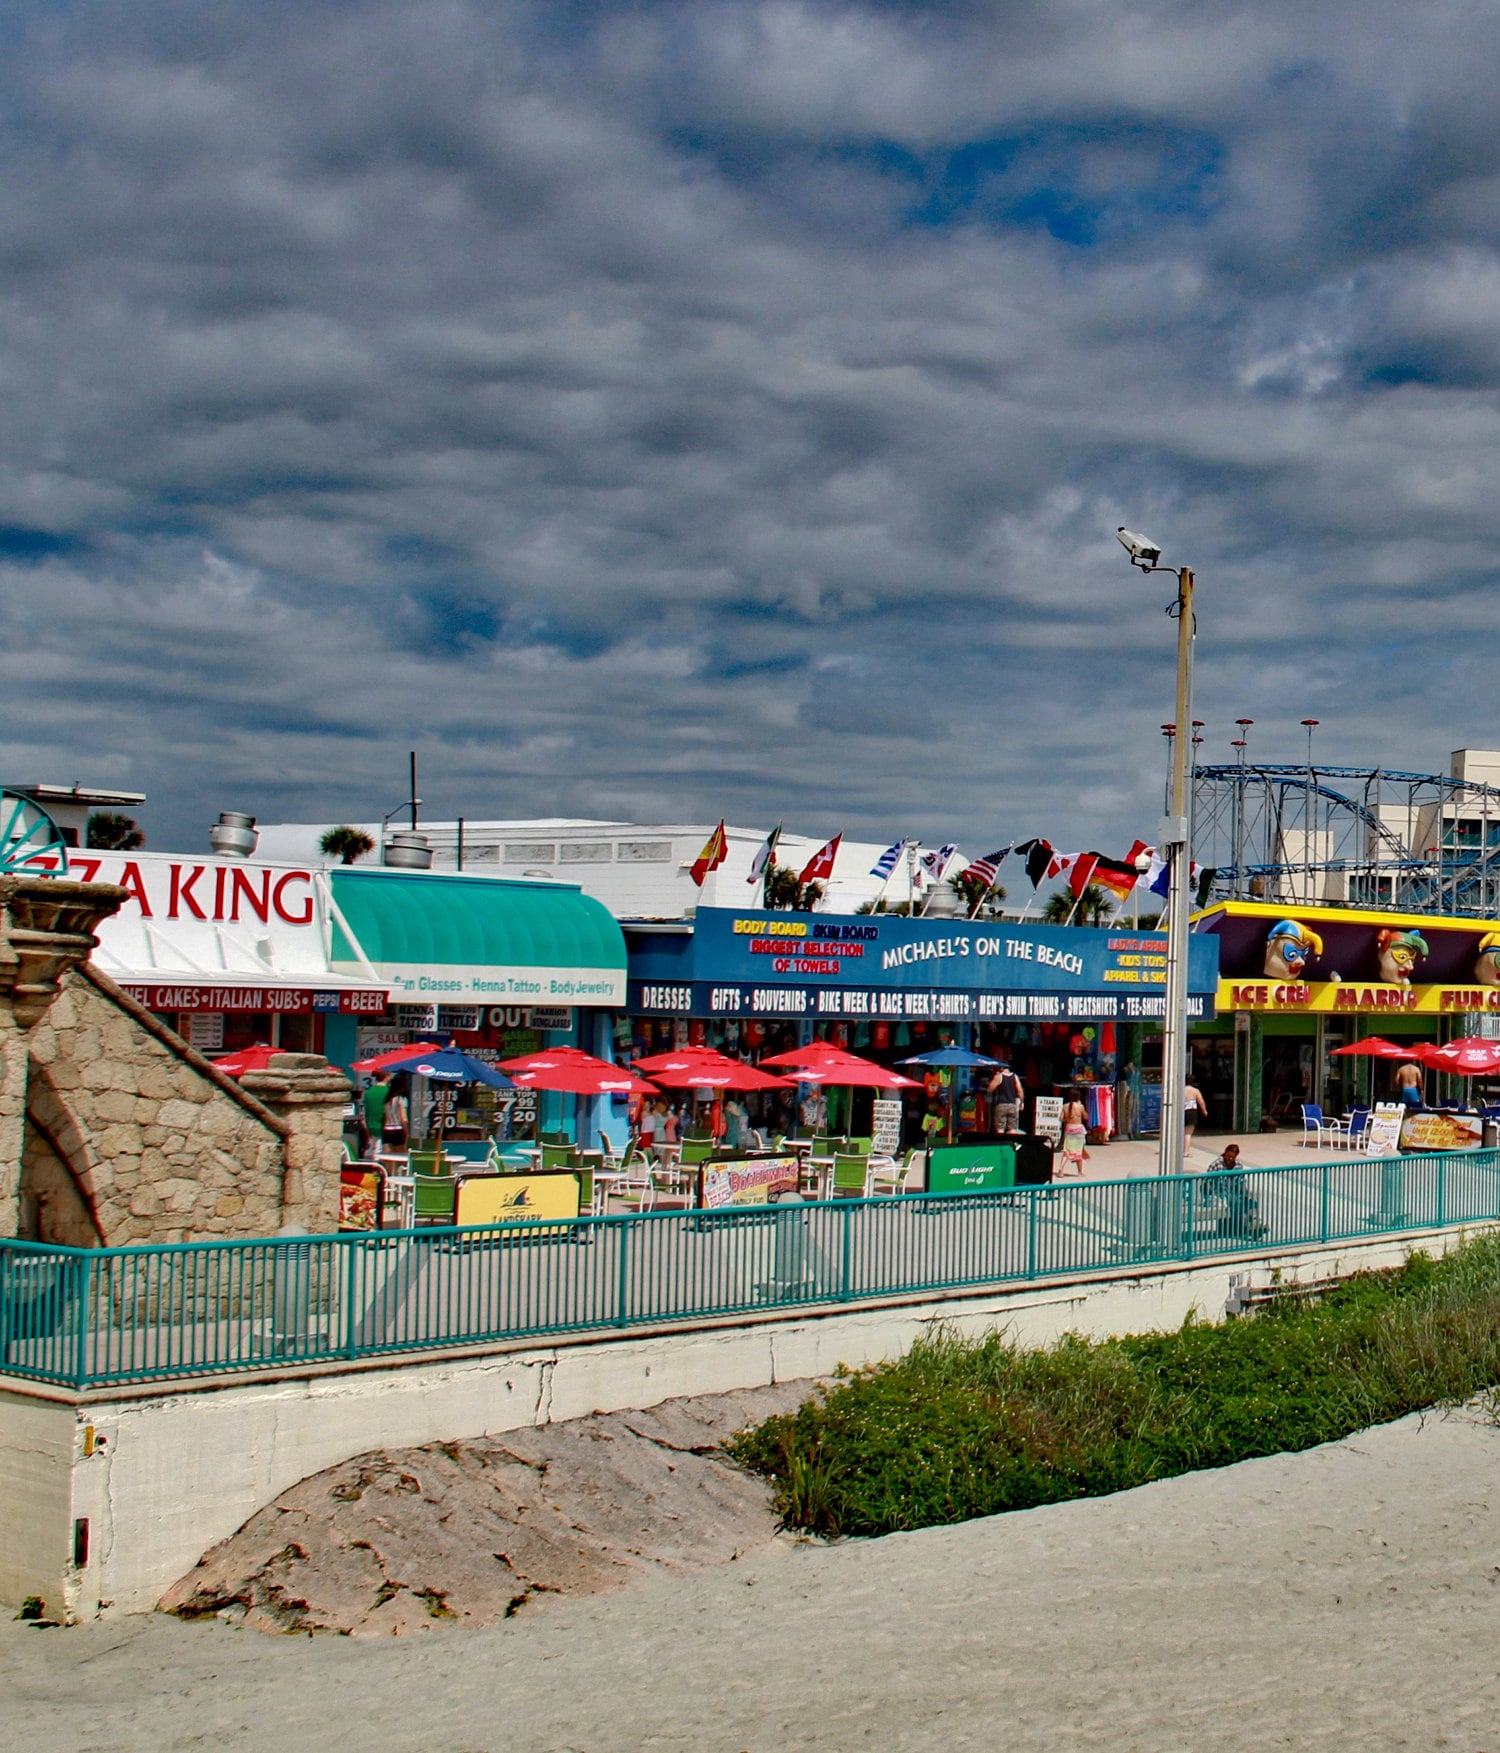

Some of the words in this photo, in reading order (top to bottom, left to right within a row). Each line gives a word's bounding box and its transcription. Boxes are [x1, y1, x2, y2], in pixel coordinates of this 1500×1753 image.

[167, 862, 314, 925] KING
[733, 919, 766, 935] BODY
[768, 921, 807, 936] BOARD
[842, 925, 879, 940] BOARD
[750, 939, 800, 955] BIGGEST
[802, 941, 863, 957] SELECTION
[882, 937, 970, 970] MICHAEL'S
[975, 937, 1000, 956] ON
[1006, 939, 1033, 961] THE
[1037, 944, 1083, 976] BEACH
[773, 958, 791, 974] OF
[794, 959, 839, 975] TOWELS
[418, 975, 462, 992] Glasses
[472, 977, 506, 992] Henna
[507, 978, 541, 993] Tattoo
[1103, 970, 1140, 983] APPAREL
[155, 987, 200, 1008] CAKES
[209, 988, 263, 1009] ITALIAN
[266, 990, 301, 1010] SUBS
[312, 993, 340, 1007] PEPSI
[350, 991, 384, 1011] BEER
[642, 986, 692, 1010] DRESSES
[711, 987, 741, 1011] GIFTS
[752, 989, 807, 1012] SOUVENIRS
[818, 990, 841, 1012] BIKE
[843, 991, 869, 1013] WEEK
[870, 993, 878, 1013] &
[879, 993, 903, 1014] RACE
[904, 994, 929, 1014] WEEK
[931, 994, 969, 1015] T-SHIRTS
[979, 995, 1005, 1015] MEN'S
[1006, 995, 1027, 1016] SWIM
[1029, 996, 1060, 1016] TRUNKS
[1067, 996, 1118, 1017] SWEATSHIRTS
[1126, 996, 1166, 1016] TEE-SHIRTS
[1232, 984, 1268, 1005] ICE
[1336, 988, 1405, 1009] MARDI
[1441, 990, 1484, 1009] FUN
[400, 1005, 436, 1015] HENNA
[489, 1006, 532, 1028] OUT
[400, 1016, 435, 1029] TATTOO
[439, 1014, 478, 1028] TURTLES
[377, 1033, 407, 1044] SALE
[360, 1047, 380, 1058] KIDS
[493, 1089, 515, 1098] TANK
[516, 1089, 537, 1098] TOPS
[518, 1097, 535, 1107] 99
[513, 1110, 536, 1122] 20
